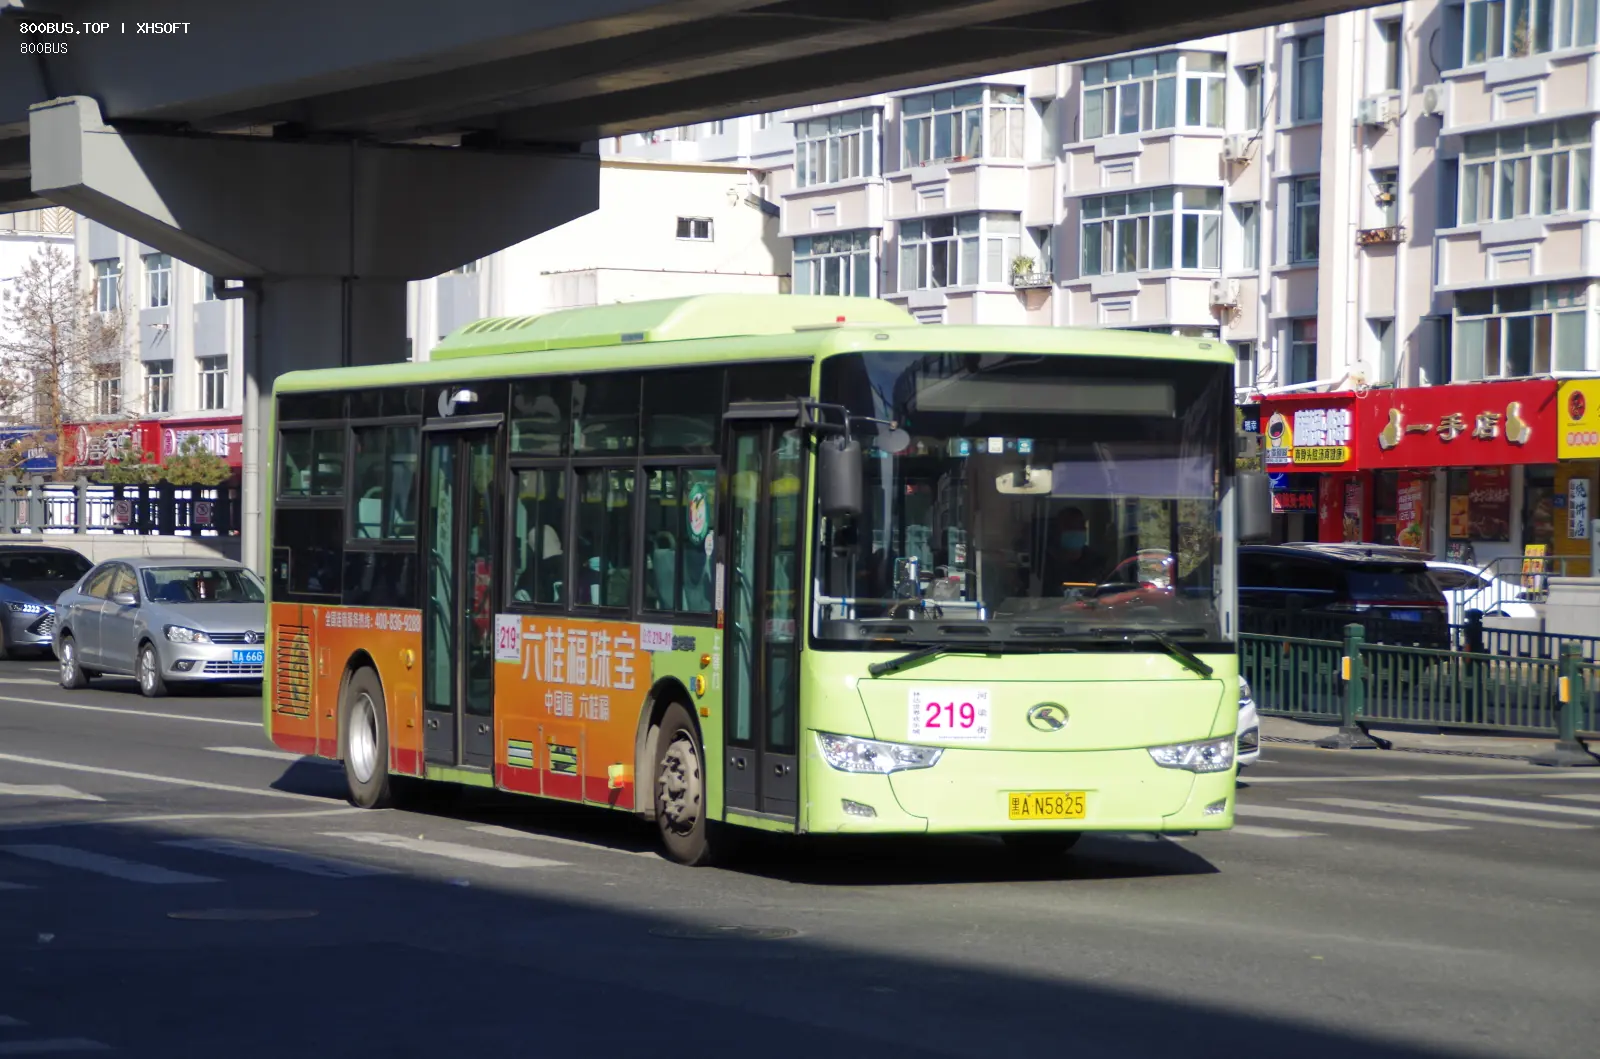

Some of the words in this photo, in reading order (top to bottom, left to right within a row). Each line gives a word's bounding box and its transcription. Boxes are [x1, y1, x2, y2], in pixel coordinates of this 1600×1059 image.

[1405, 411, 1501, 441] 一手店
[500, 626, 516, 649] 219
[521, 624, 636, 690] 六桂福珠宝
[545, 688, 574, 717] 中国福
[579, 692, 610, 722] 六桂福
[925, 702, 975, 728] 219
